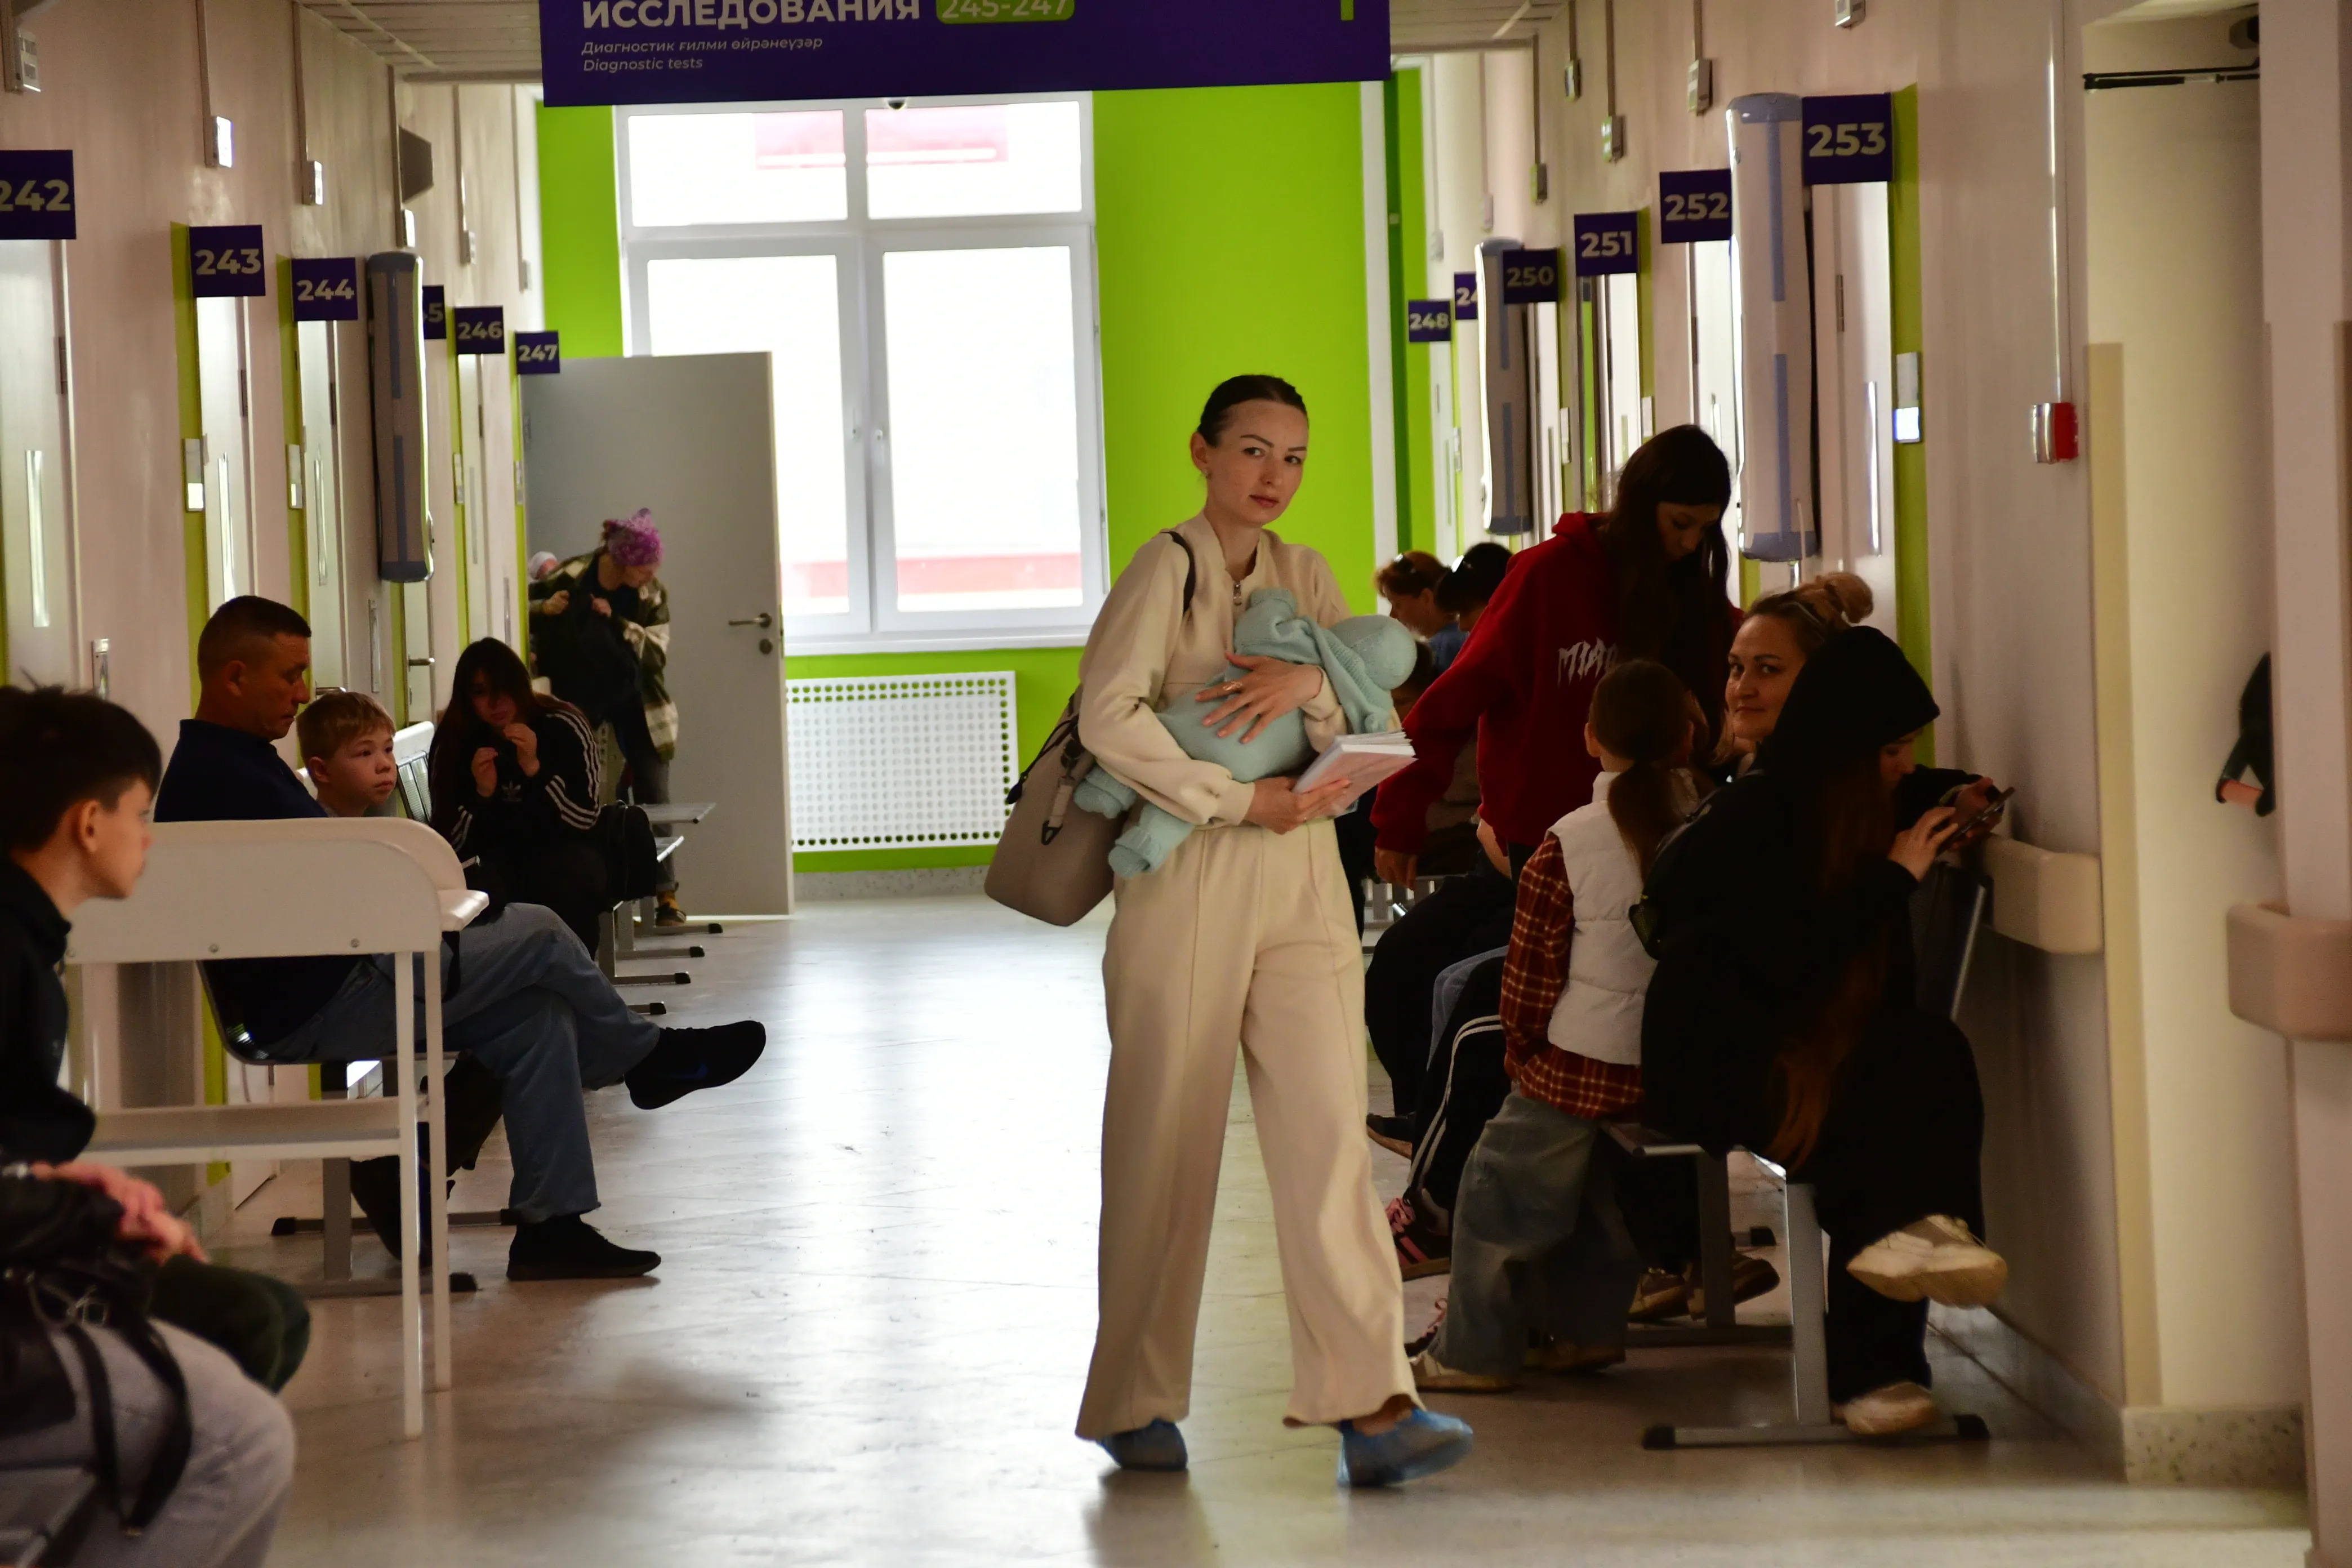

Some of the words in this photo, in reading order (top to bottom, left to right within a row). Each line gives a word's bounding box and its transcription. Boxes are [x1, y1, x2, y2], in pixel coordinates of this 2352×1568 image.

[582, 0, 920, 30] ИССЛЕДОВАНИЯ
[581, 41, 675, 56] Диагностик
[583, 57, 664, 74] Diagnostic
[668, 57, 703, 69] tests
[1806, 122, 1886, 158] 253
[0, 179, 72, 211] 242
[1663, 191, 1730, 221] 252
[1579, 230, 1633, 259] 251
[194, 248, 262, 275] 243
[1506, 266, 1554, 287] 250
[296, 278, 355, 302] 244
[457, 320, 503, 340] 246
[1409, 312, 1450, 331] 248
[518, 344, 558, 362] 247
